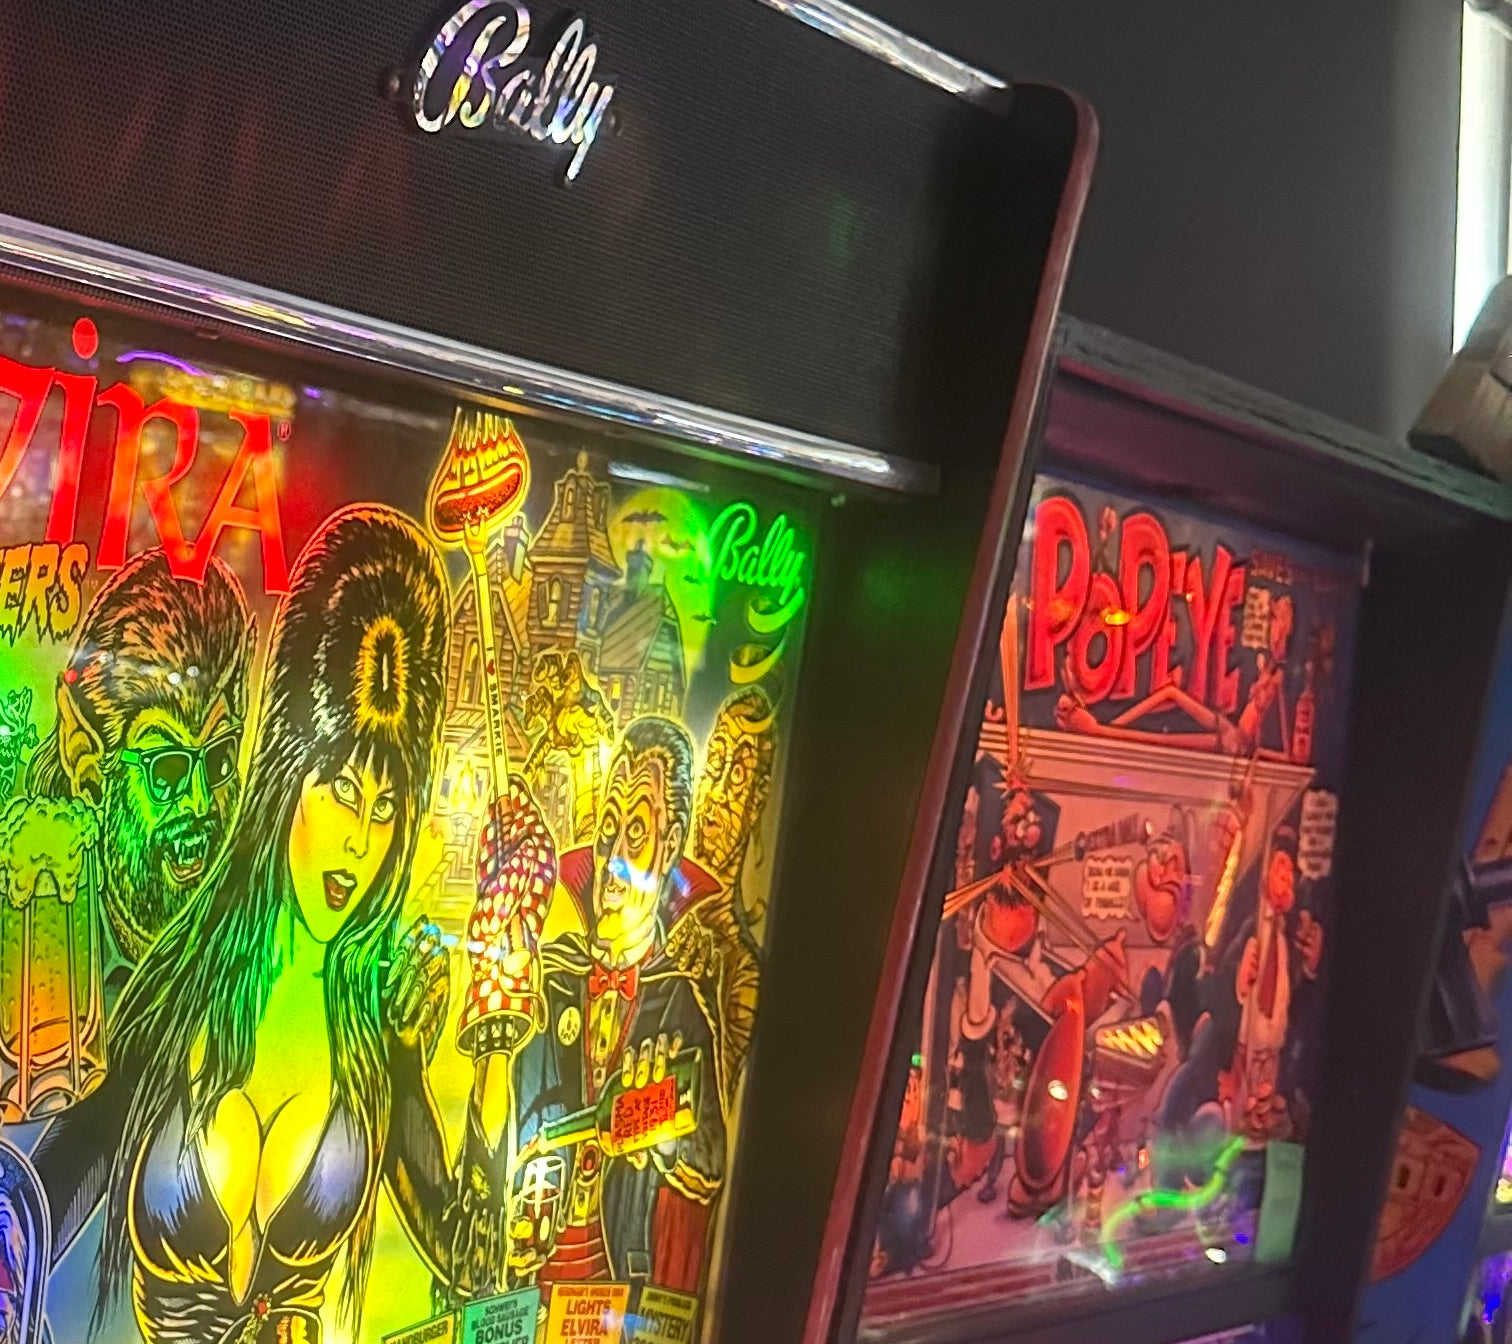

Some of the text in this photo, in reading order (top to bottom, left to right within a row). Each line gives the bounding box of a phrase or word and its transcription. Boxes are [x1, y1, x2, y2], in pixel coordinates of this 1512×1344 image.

[711, 503, 806, 605] Bally
[1024, 497, 1245, 713] POPEYE
[560, 1318, 608, 1336] ELVIRA
[566, 1299, 611, 1316] LIGHTS
